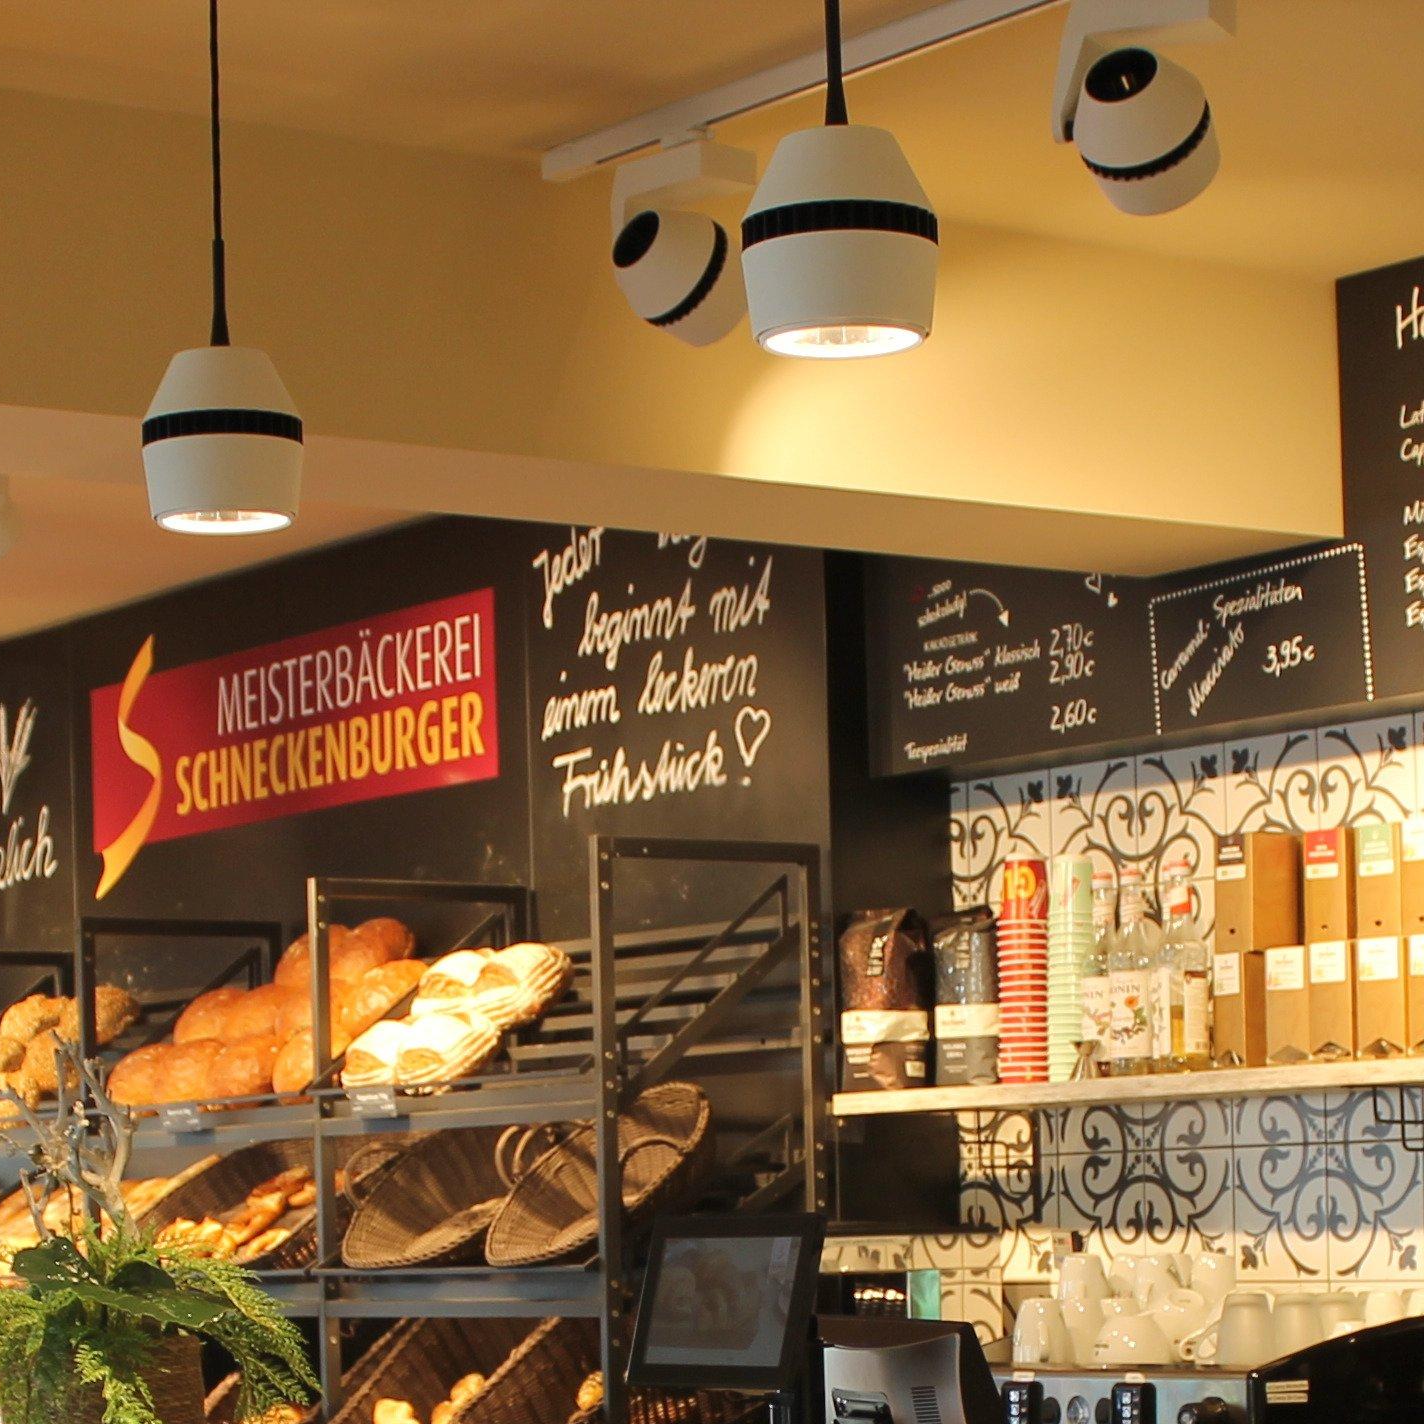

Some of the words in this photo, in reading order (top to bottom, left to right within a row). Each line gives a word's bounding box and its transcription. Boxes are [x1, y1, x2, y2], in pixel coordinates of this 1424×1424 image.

[578, 577, 696, 671] beginnt
[709, 554, 773, 633] mit
[217, 613, 482, 736] MEISTERBÄCKEREI
[540, 669, 621, 742] einem
[637, 646, 758, 715] leckeren
[175, 691, 485, 816] SCHNECKENBURGER
